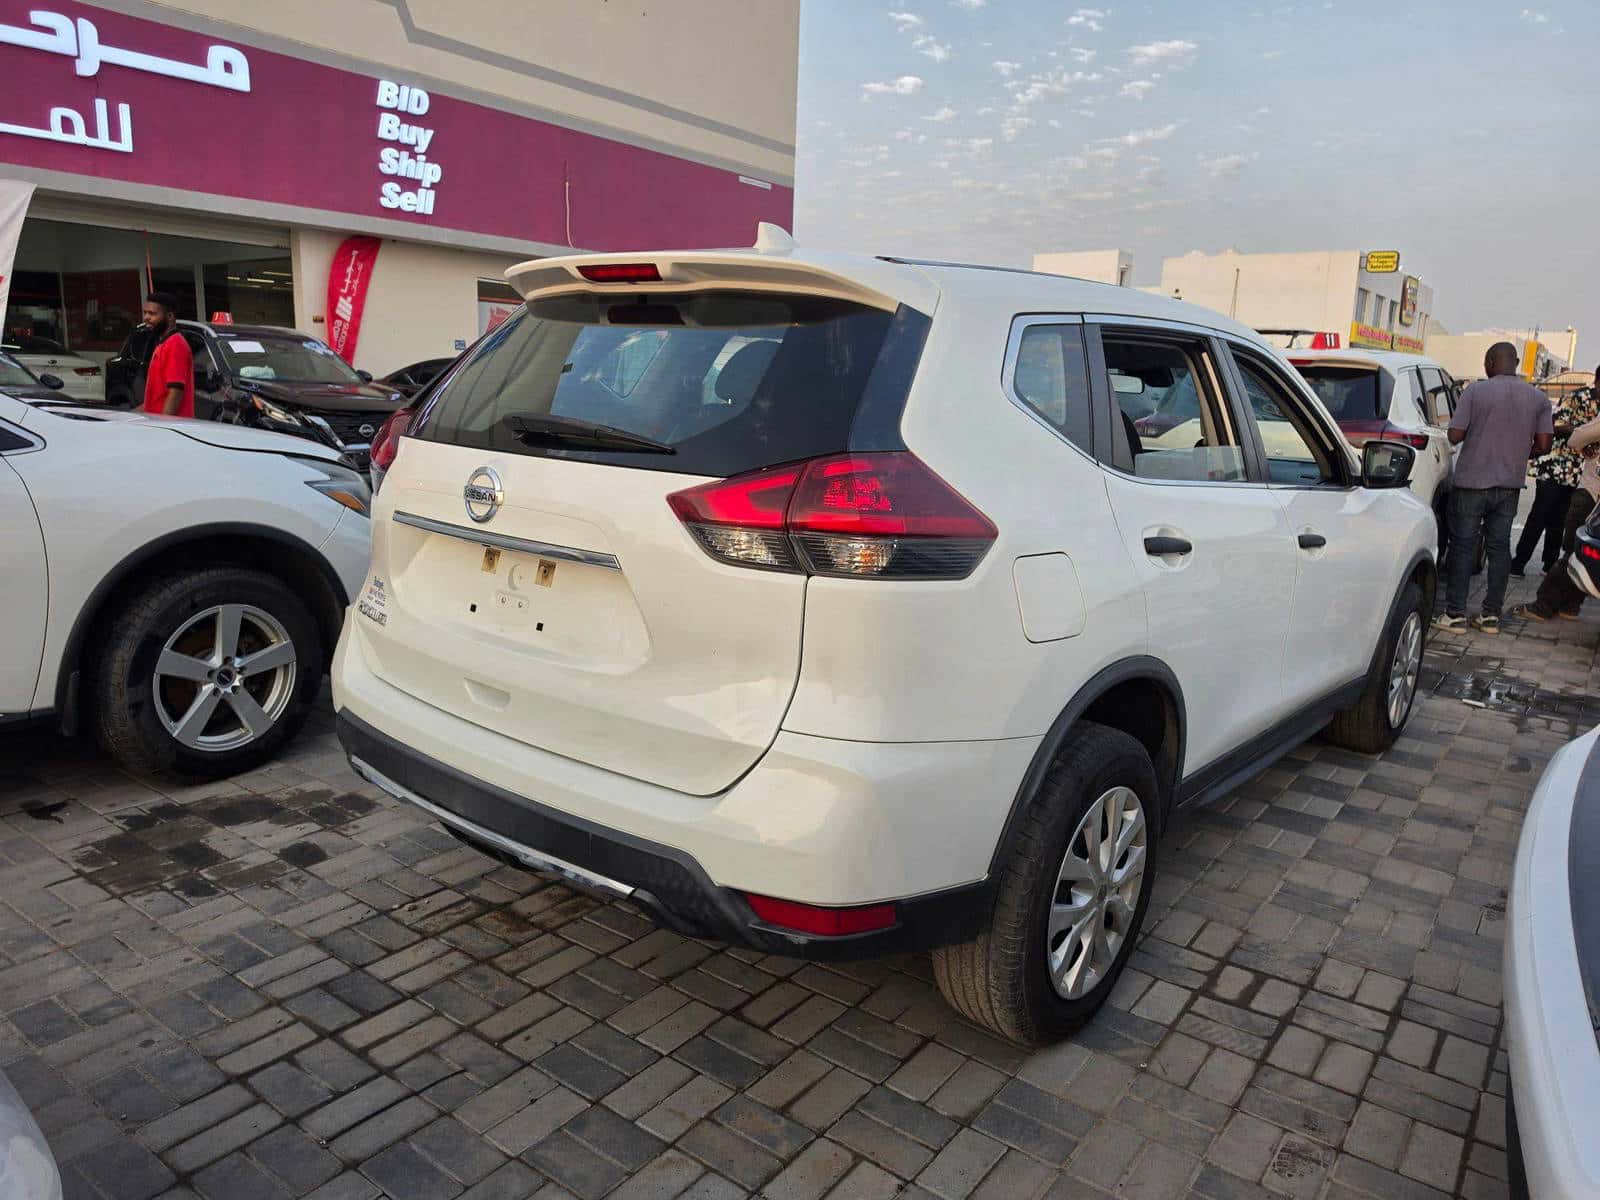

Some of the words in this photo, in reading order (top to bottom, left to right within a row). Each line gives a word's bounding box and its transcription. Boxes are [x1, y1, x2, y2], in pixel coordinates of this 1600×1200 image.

[0, 11, 251, 93] مرح
[376, 80, 430, 115] BID
[0, 99, 134, 153] للم
[377, 112, 435, 153] Buy
[378, 147, 442, 187] Ship
[379, 182, 436, 214] Sell
